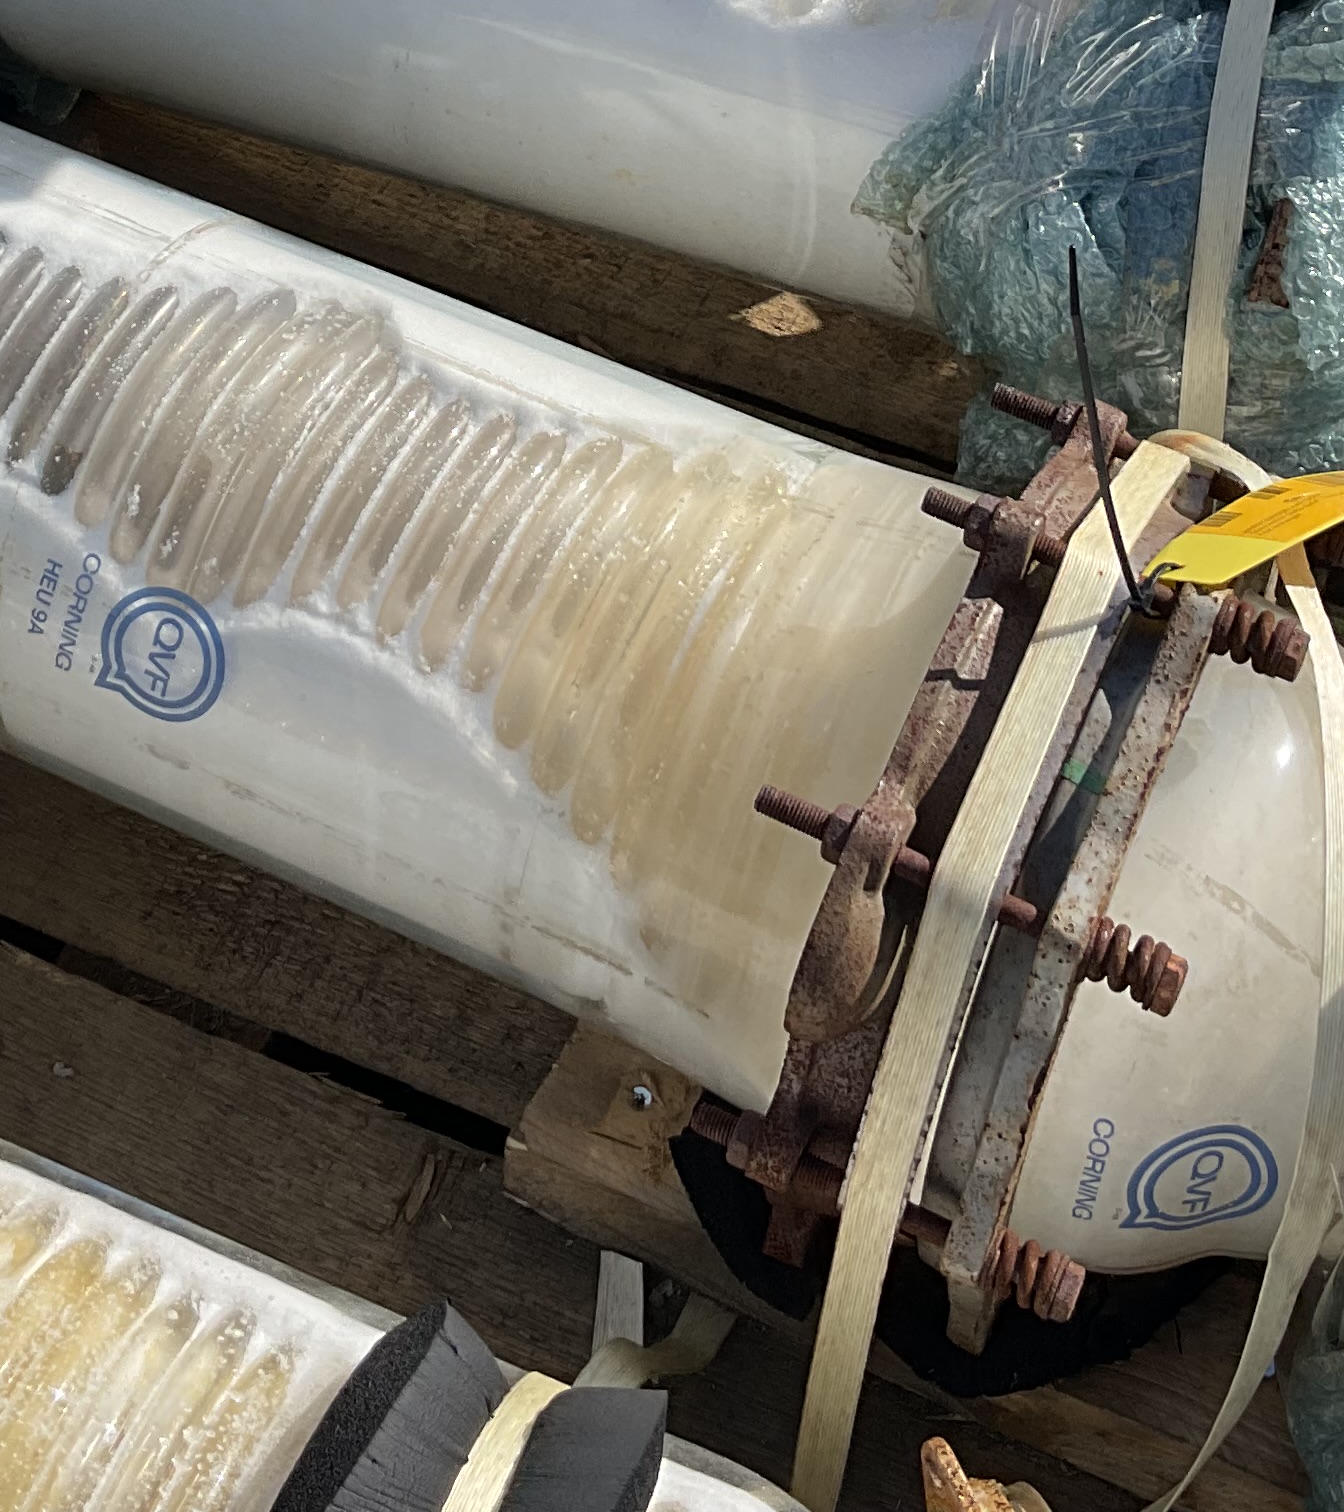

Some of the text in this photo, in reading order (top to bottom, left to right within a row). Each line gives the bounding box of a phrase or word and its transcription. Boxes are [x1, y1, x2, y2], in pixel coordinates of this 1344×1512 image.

[36, 558, 63, 606] HEU
[54, 552, 102, 672] CORNING
[144, 617, 184, 698] QVF
[1071, 1117, 1116, 1221] CORNING
[1181, 1149, 1225, 1214] QVF
